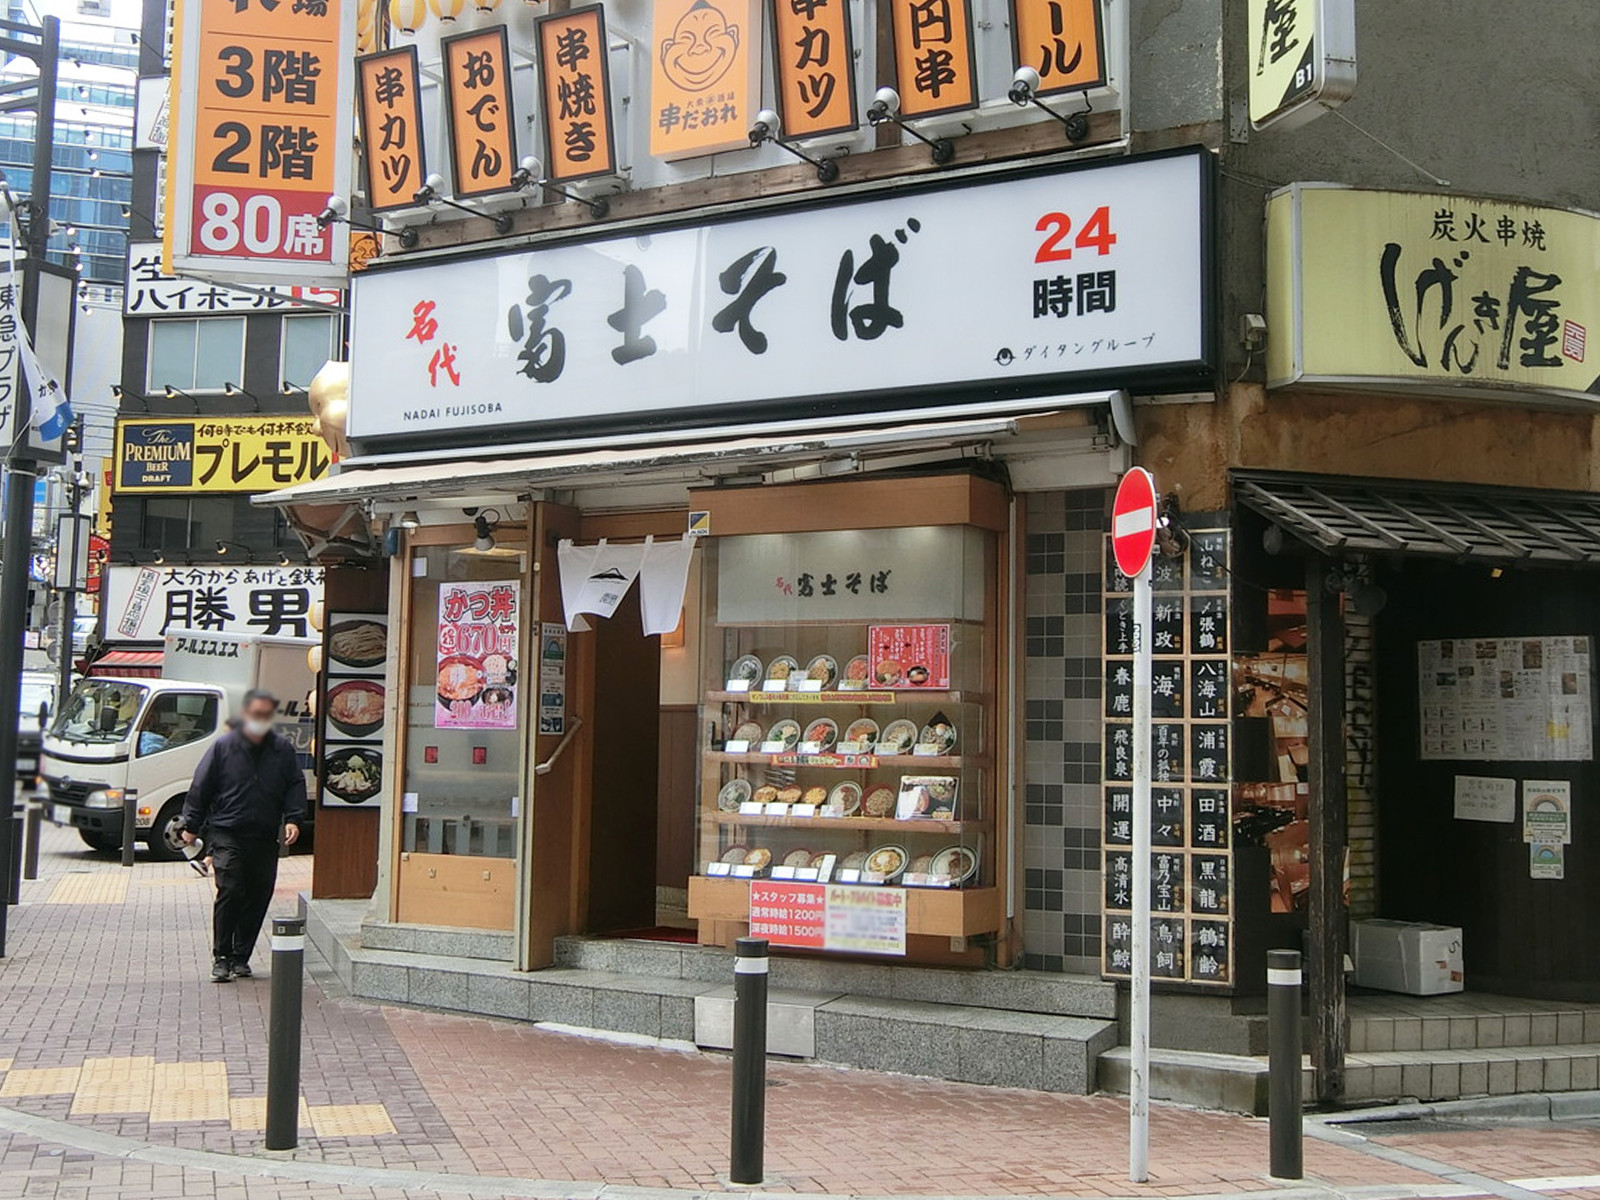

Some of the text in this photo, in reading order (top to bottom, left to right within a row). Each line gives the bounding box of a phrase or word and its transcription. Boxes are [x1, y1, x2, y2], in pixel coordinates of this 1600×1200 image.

[215, 46, 321, 105] 3階
[556, 27, 597, 163] 串焼き
[1295, 63, 1312, 89] B1
[375, 66, 411, 195] 串カツ
[462, 51, 503, 181] おでん
[659, 103, 738, 135] 串だおれ
[211, 121, 320, 181] 2階
[200, 192, 326, 257] 80席
[1034, 205, 1118, 264] 24
[1429, 208, 1547, 252] 炭火串焼
[508, 217, 921, 384] 富士そば
[1032, 269, 1117, 319] 時間
[1380, 243, 1564, 374] げんき屋
[405, 300, 461, 388] 名代
[1023, 332, 1157, 361] ダイタングループ
[403, 402, 502, 422] NADAI FUJISOBA
[124, 441, 192, 462] PREMIUM
[142, 428, 177, 444] The
[142, 474, 172, 483] DRAFT
[146, 462, 169, 472] BEER
[196, 438, 330, 486] プレモル
[443, 586, 517, 623] かつ丼
[797, 569, 892, 598] 富士そば
[159, 587, 310, 638] 勝男
[1154, 603, 1174, 648] 新政
[1113, 666, 1132, 712] 春鹿
[1153, 675, 1175, 697] 海
[1197, 663, 1217, 717] 八海山
[1198, 730, 1217, 778] 浦霞
[1112, 793, 1131, 840] 開運
[1157, 795, 1172, 837] 中々
[1198, 798, 1216, 842] 田酒
[1114, 856, 1129, 905] 高清水
[1198, 861, 1218, 909] 黒龍
[1112, 922, 1131, 969] 酔鯨
[1156, 923, 1174, 970] 鳥飼
